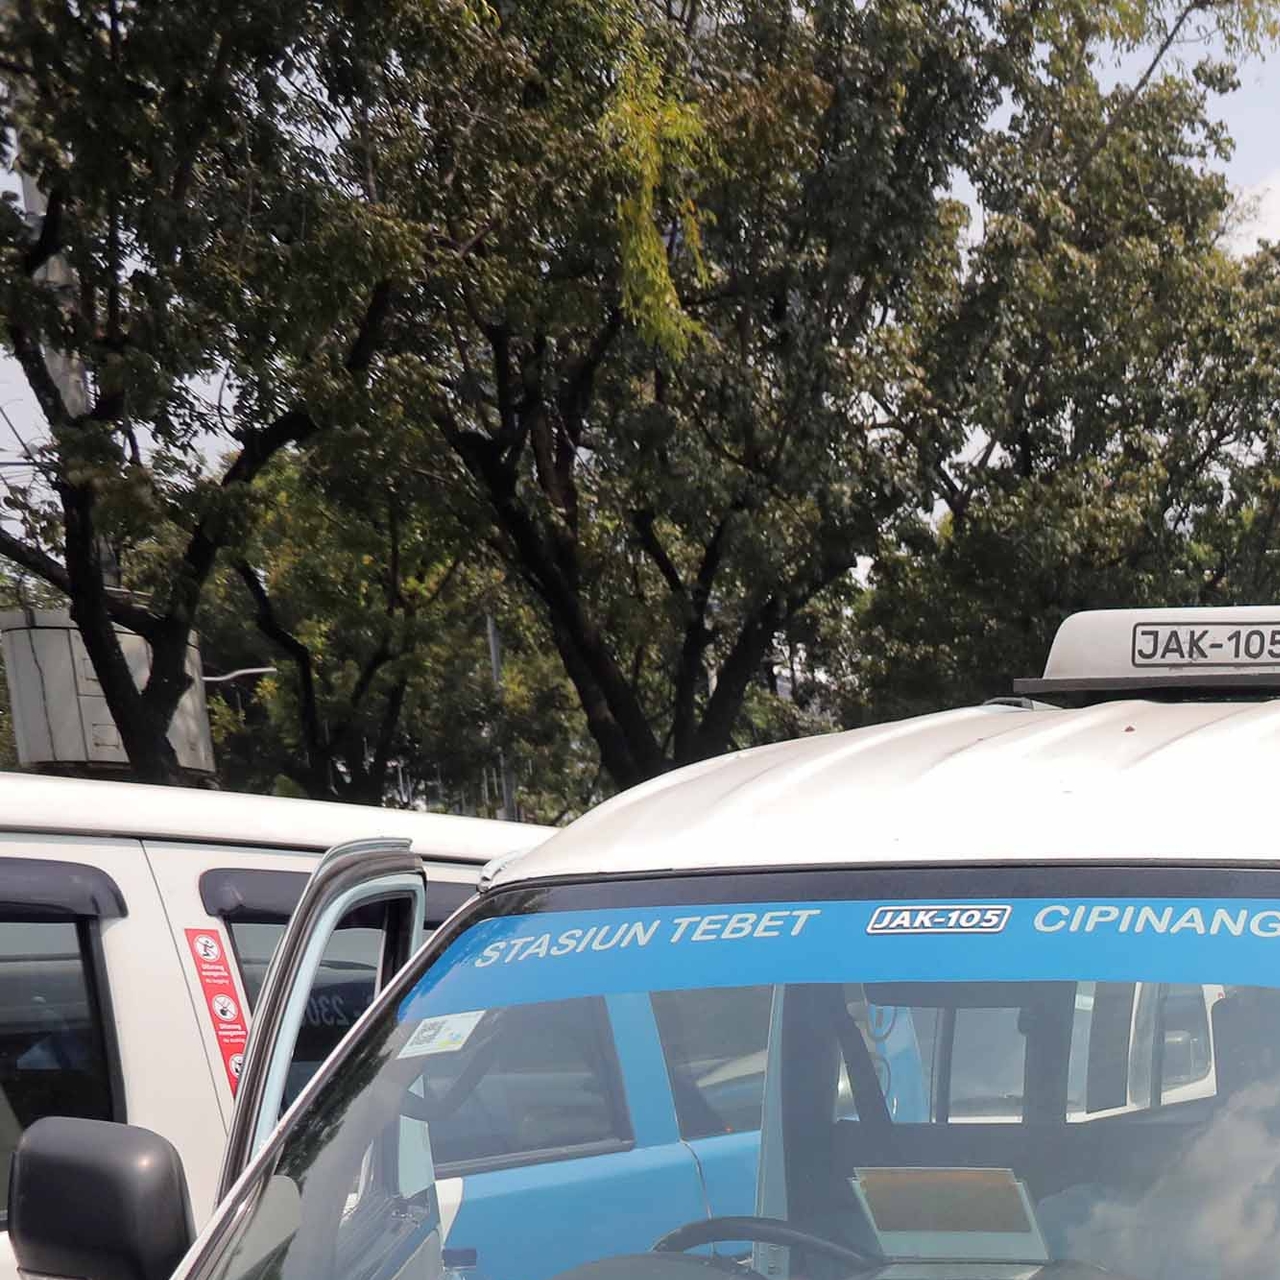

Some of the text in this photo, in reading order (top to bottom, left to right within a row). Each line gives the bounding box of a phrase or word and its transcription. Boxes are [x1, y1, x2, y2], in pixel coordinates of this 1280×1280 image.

[474, 920, 659, 968] STASIUN
[669, 909, 822, 944] TEBET
[873, 910, 1003, 929] JAK-105
